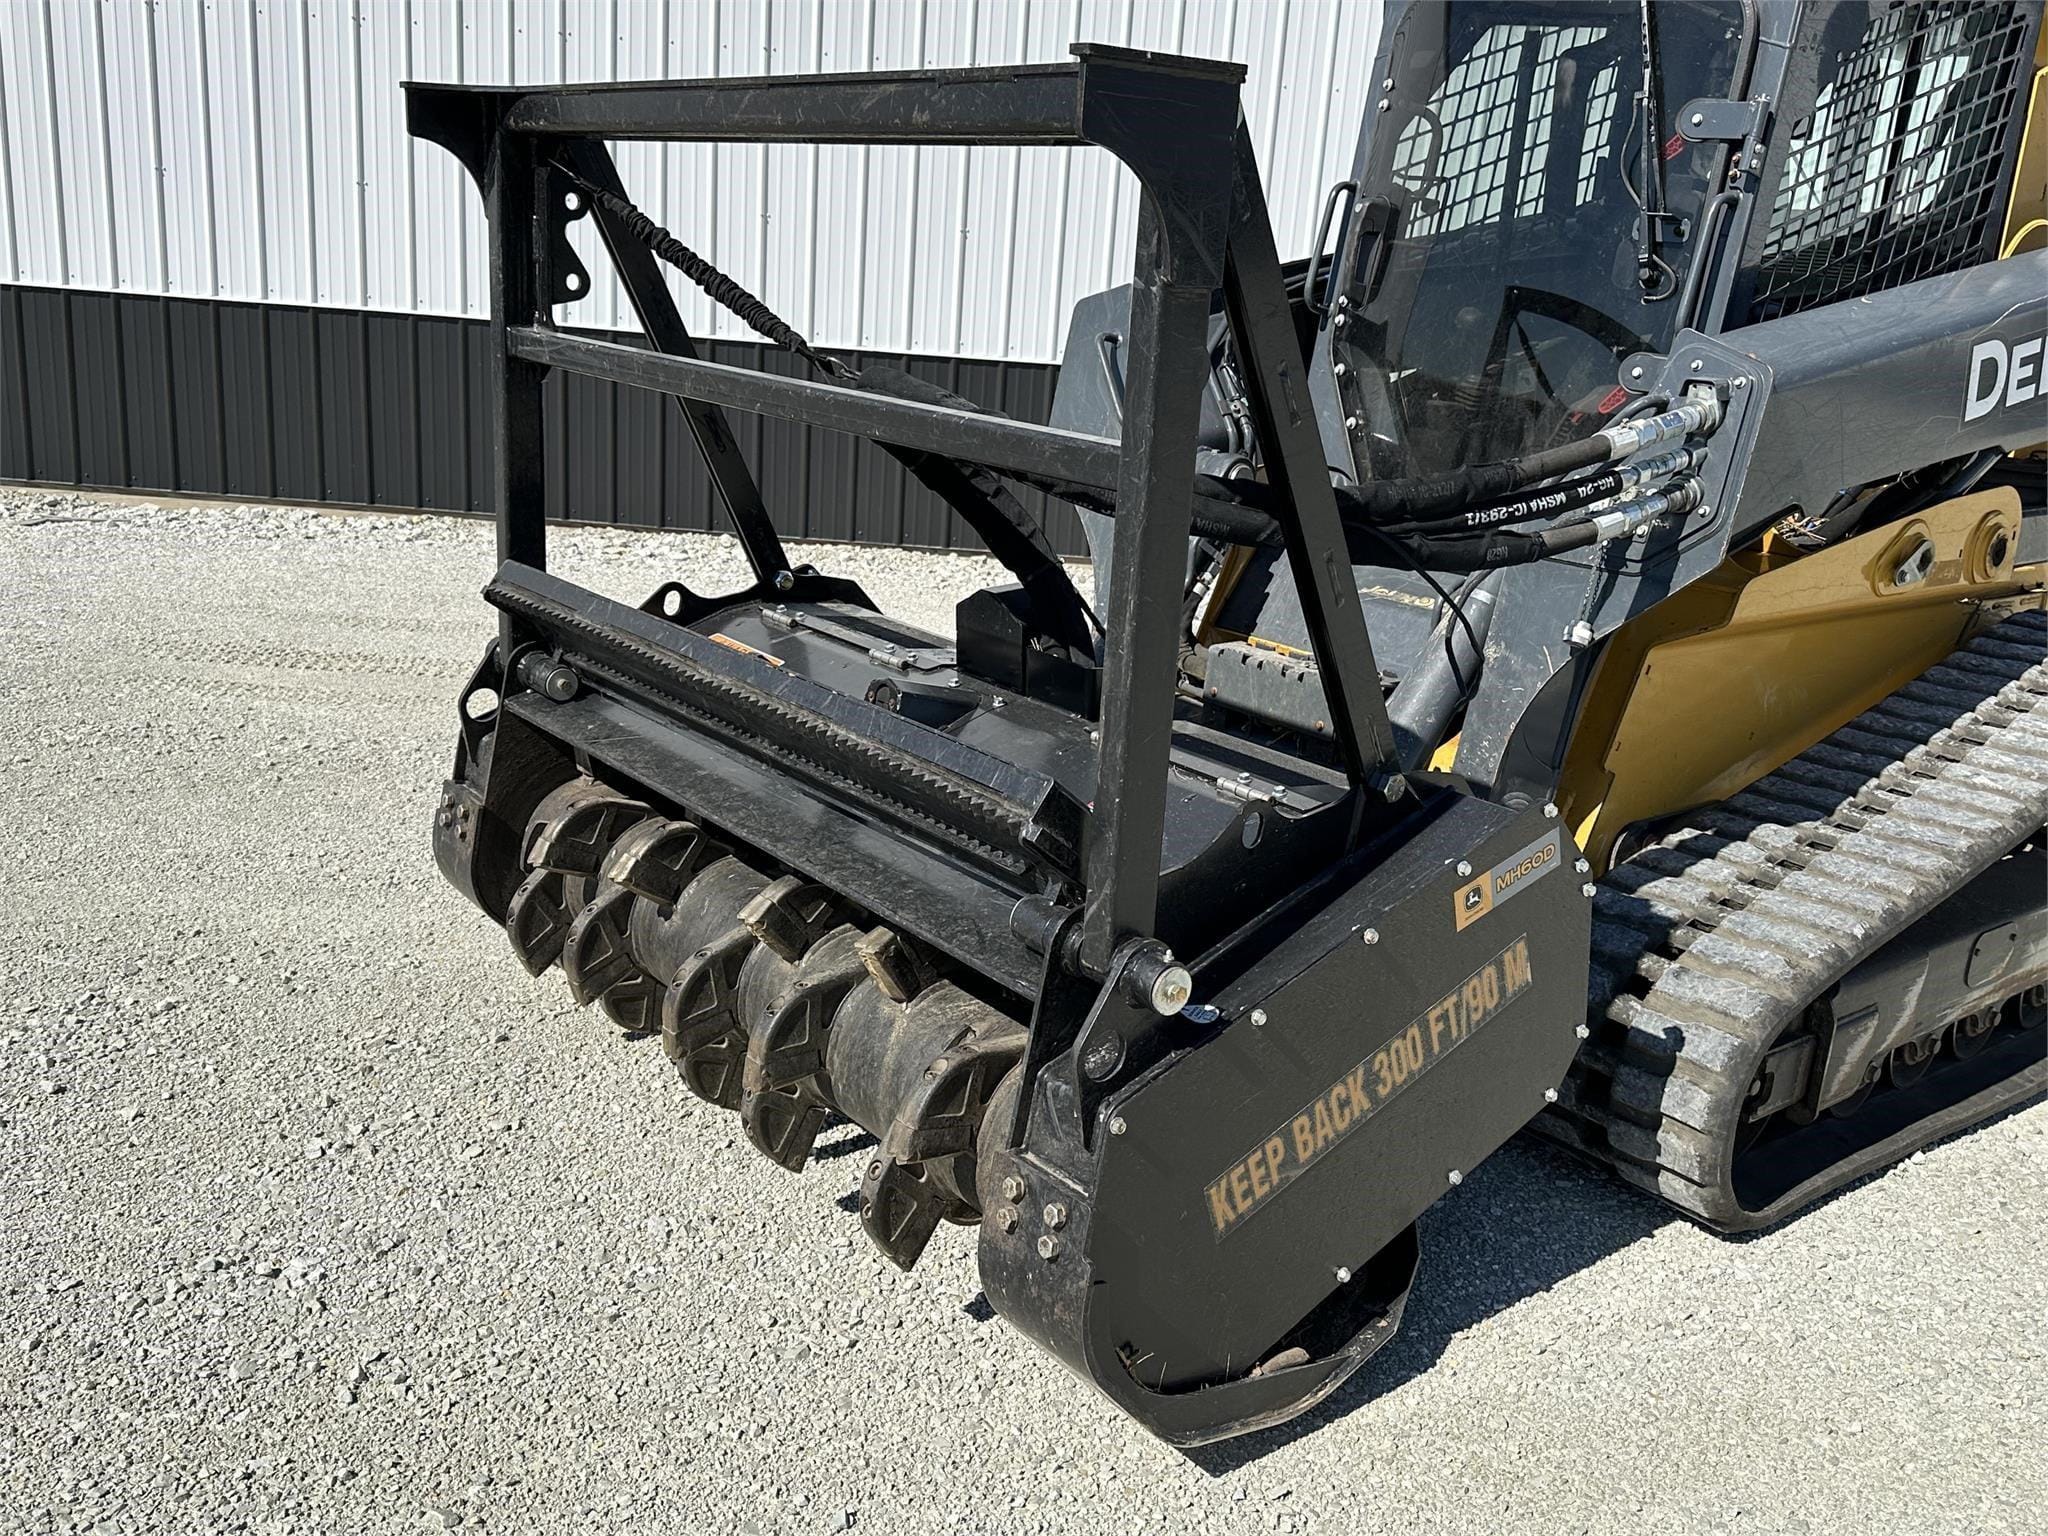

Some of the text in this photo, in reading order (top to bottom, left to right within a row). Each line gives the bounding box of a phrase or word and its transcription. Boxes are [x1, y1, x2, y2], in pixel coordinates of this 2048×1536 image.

[1531, 493, 1567, 512] MSHA
[1496, 844, 1556, 893] MH60D
[1207, 941, 1532, 1232] KEEP BACK 300 FT/90 M
